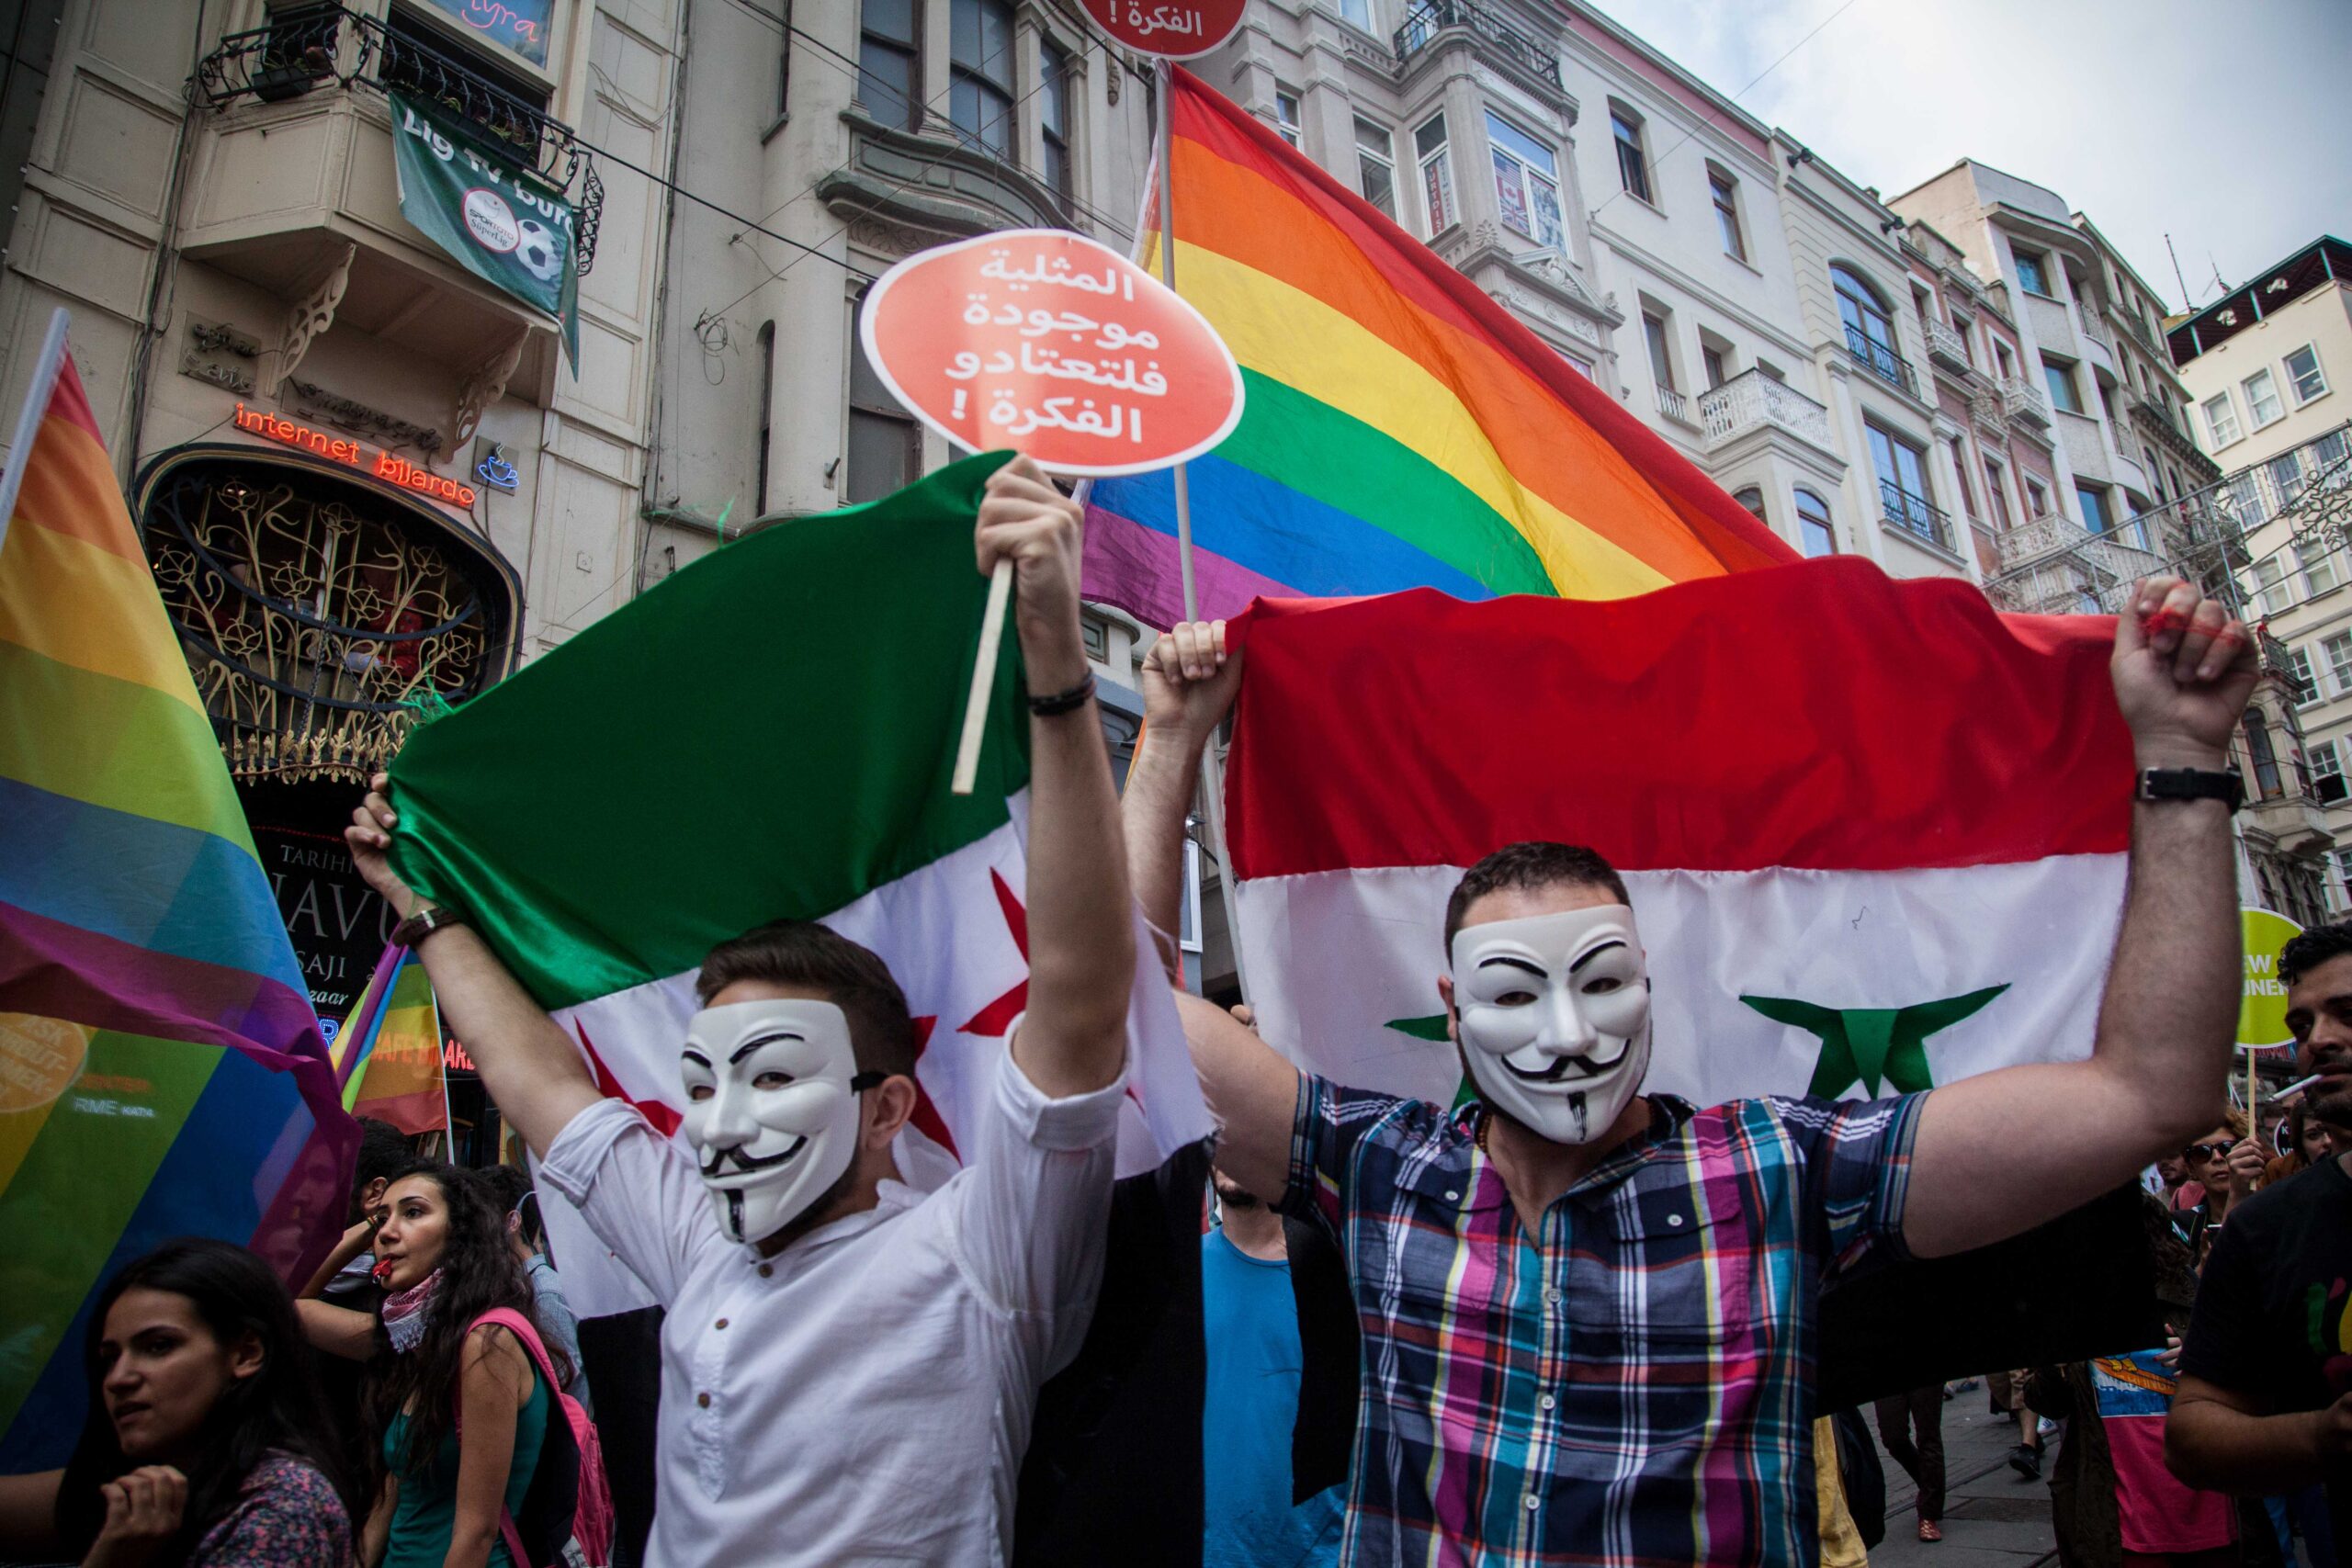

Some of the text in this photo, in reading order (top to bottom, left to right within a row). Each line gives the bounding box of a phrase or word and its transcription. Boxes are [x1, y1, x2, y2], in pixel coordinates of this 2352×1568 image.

[1128, 1, 1203, 36] الفكرة
[403, 107, 456, 163] Lig
[979, 249, 1135, 301] المثلية
[963, 293, 1159, 350] موجودة
[944, 342, 1168, 397] فلتعتادو
[235, 402, 360, 464] internet
[951, 389, 1142, 444] الفكرة !
